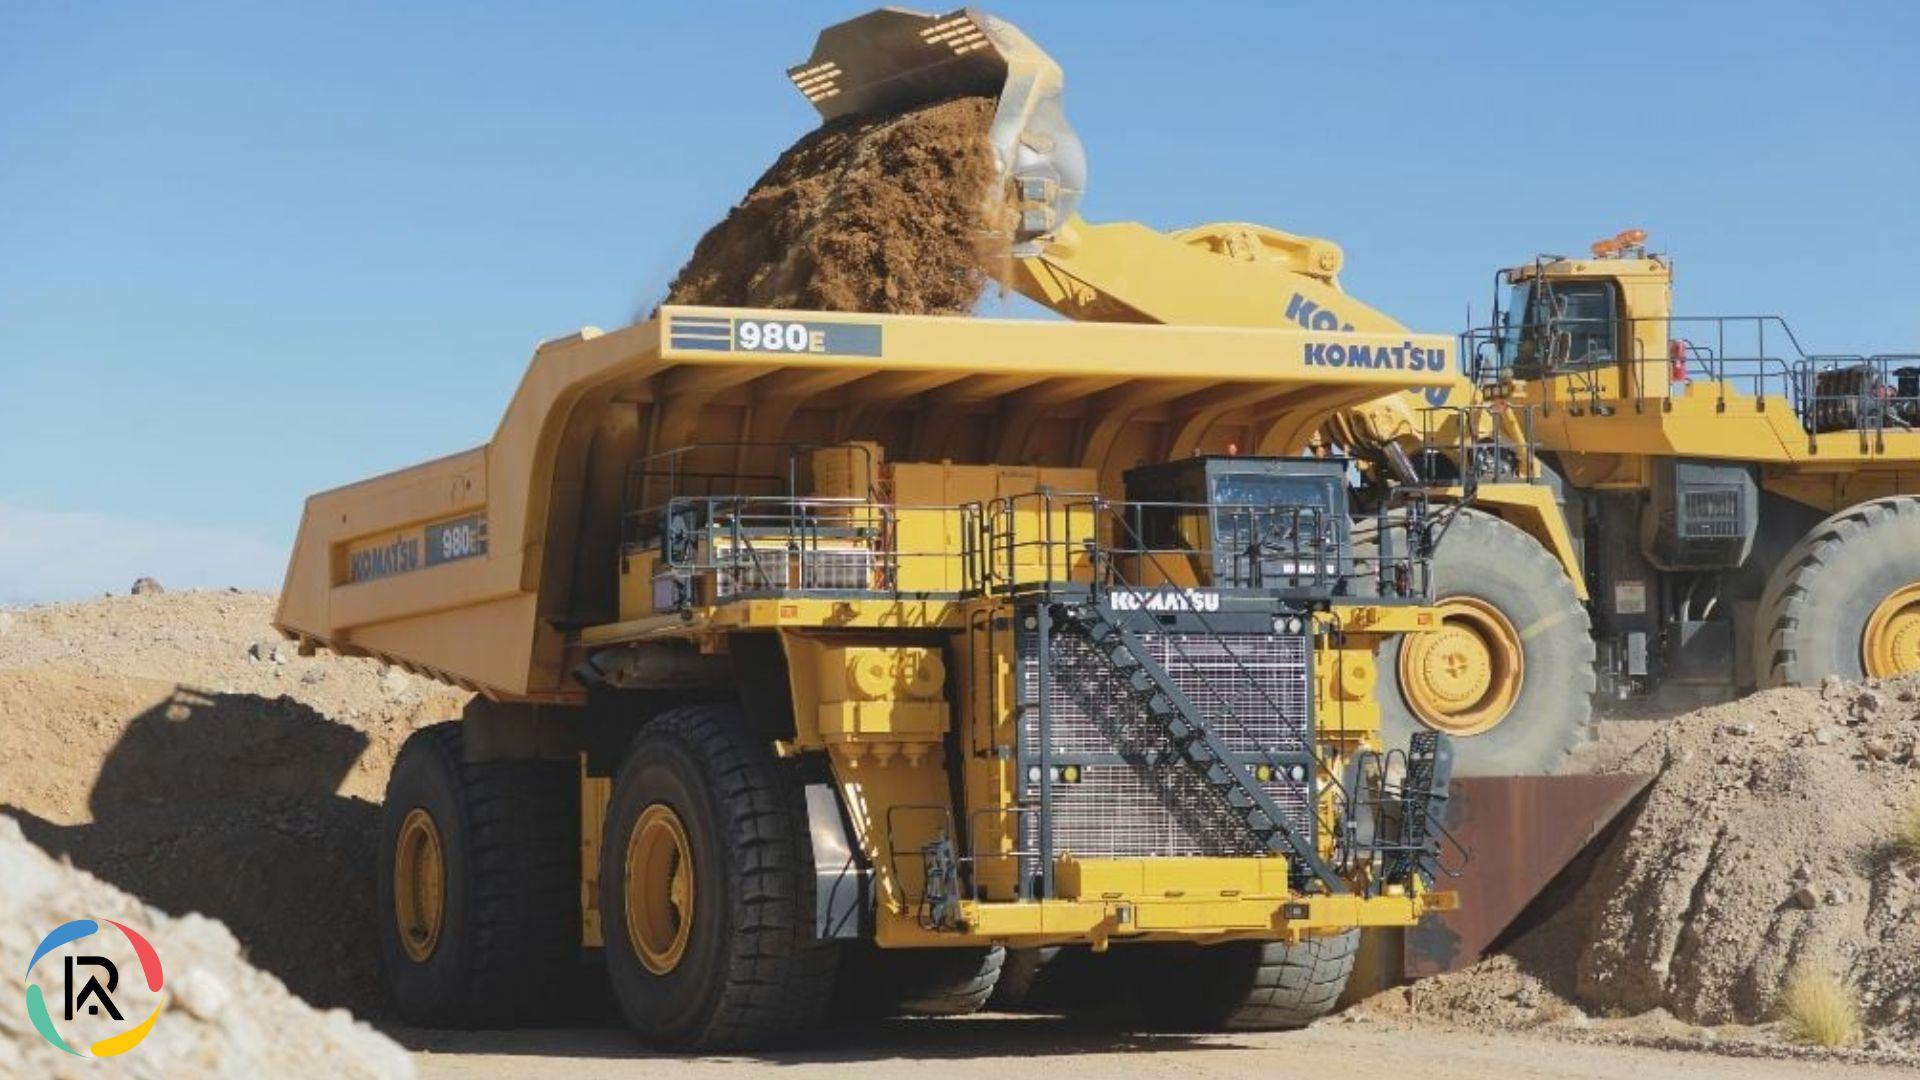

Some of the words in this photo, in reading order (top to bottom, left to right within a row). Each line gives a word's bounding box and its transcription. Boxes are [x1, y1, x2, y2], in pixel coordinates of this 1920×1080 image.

[739, 321, 825, 352] 980E
[1304, 341, 1445, 371] KOMATSU
[1111, 587, 1220, 612] KOMATSU
